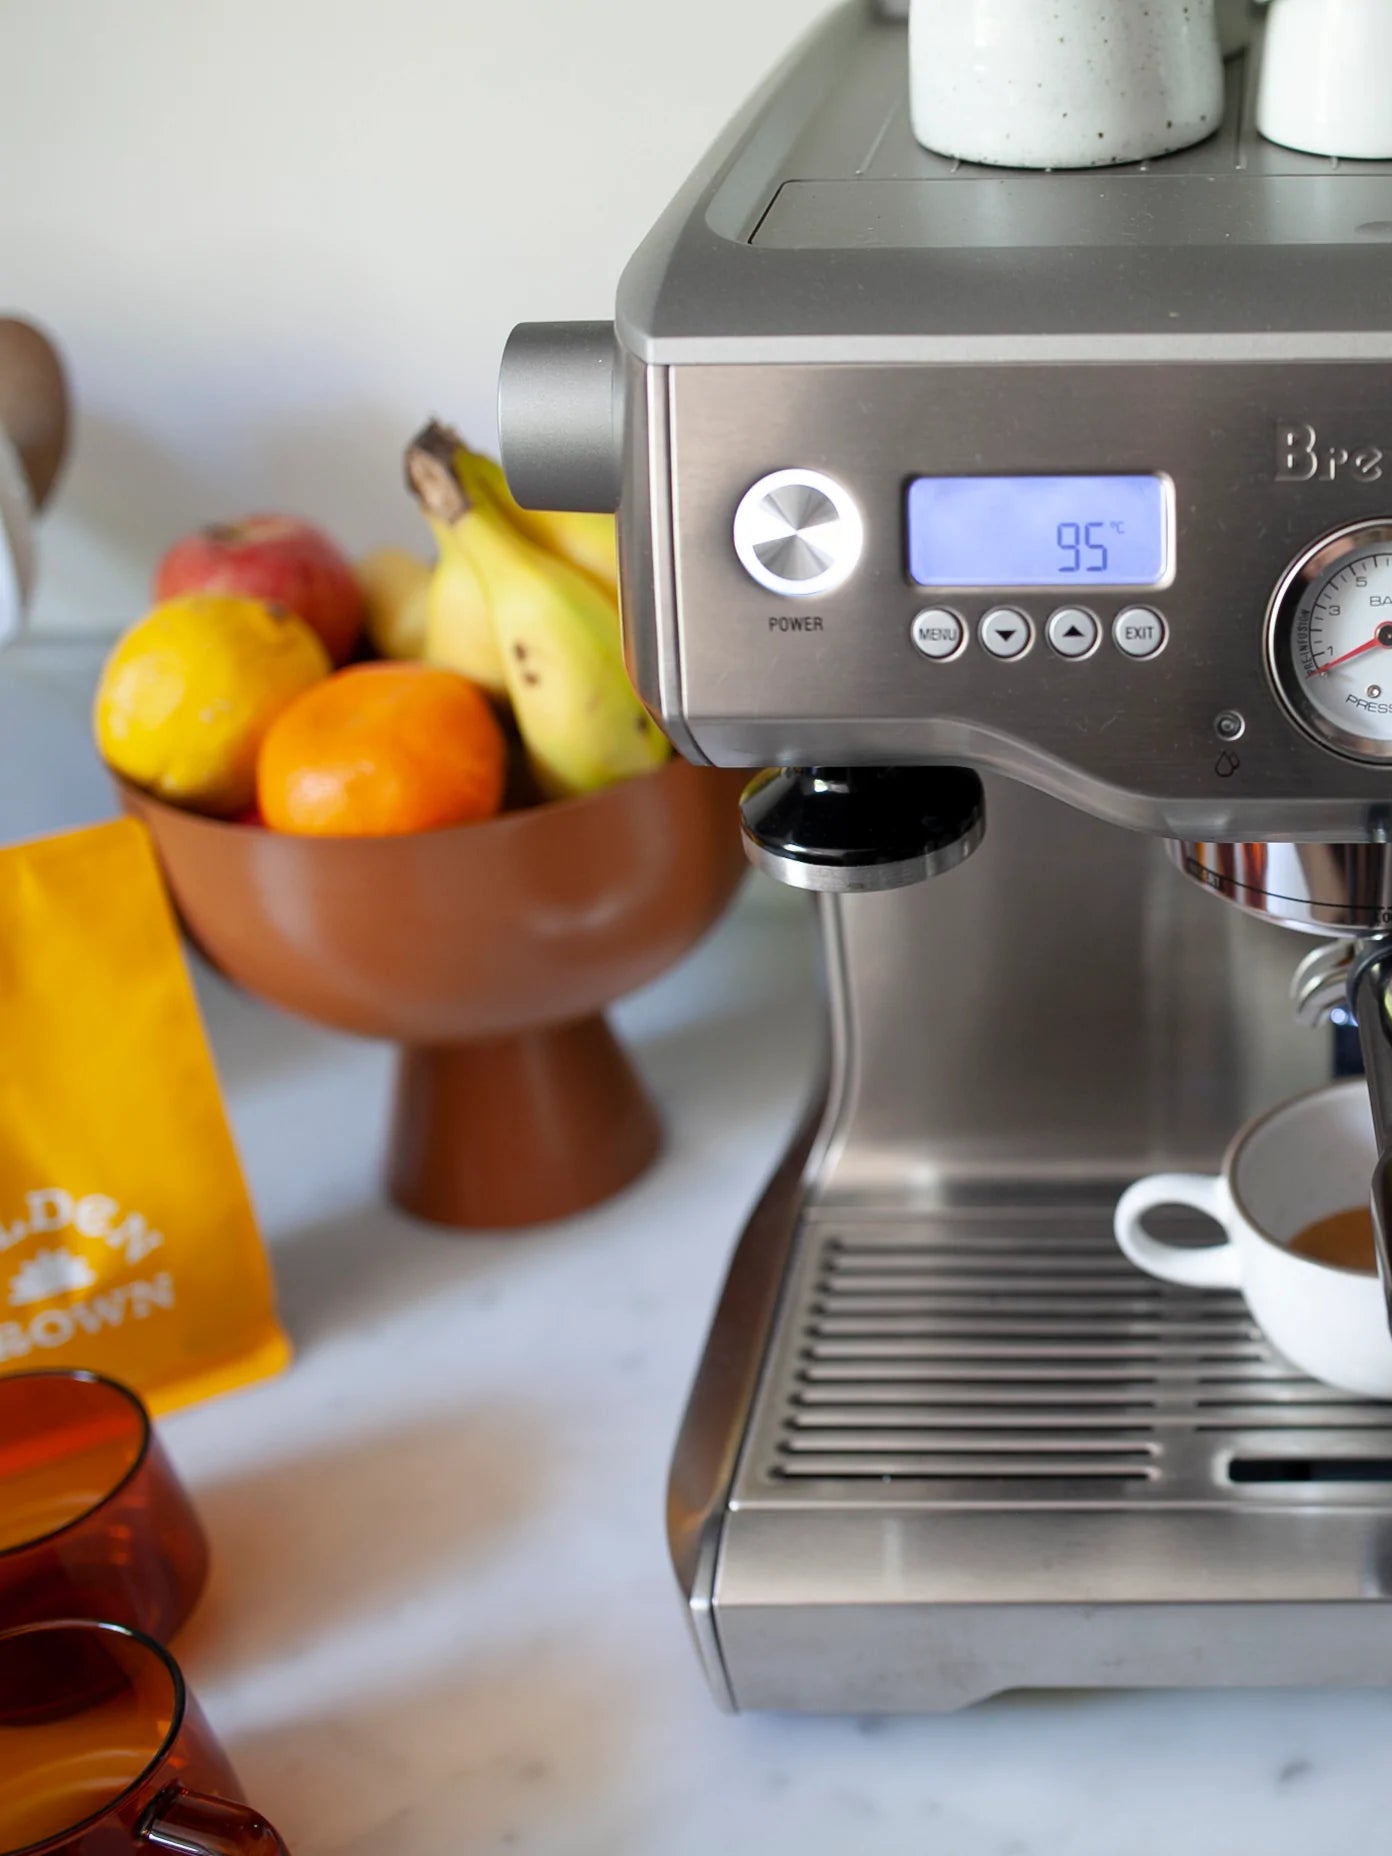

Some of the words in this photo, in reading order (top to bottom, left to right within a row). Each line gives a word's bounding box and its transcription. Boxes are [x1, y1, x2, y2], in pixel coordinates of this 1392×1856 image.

[1355, 576, 1368, 588] 5
[1328, 605, 1341, 616] 3
[768, 616, 824, 632] POWER
[918, 627, 958, 641] MENU
[1125, 626, 1154, 640] EXIT
[1326, 645, 1334, 656] 1
